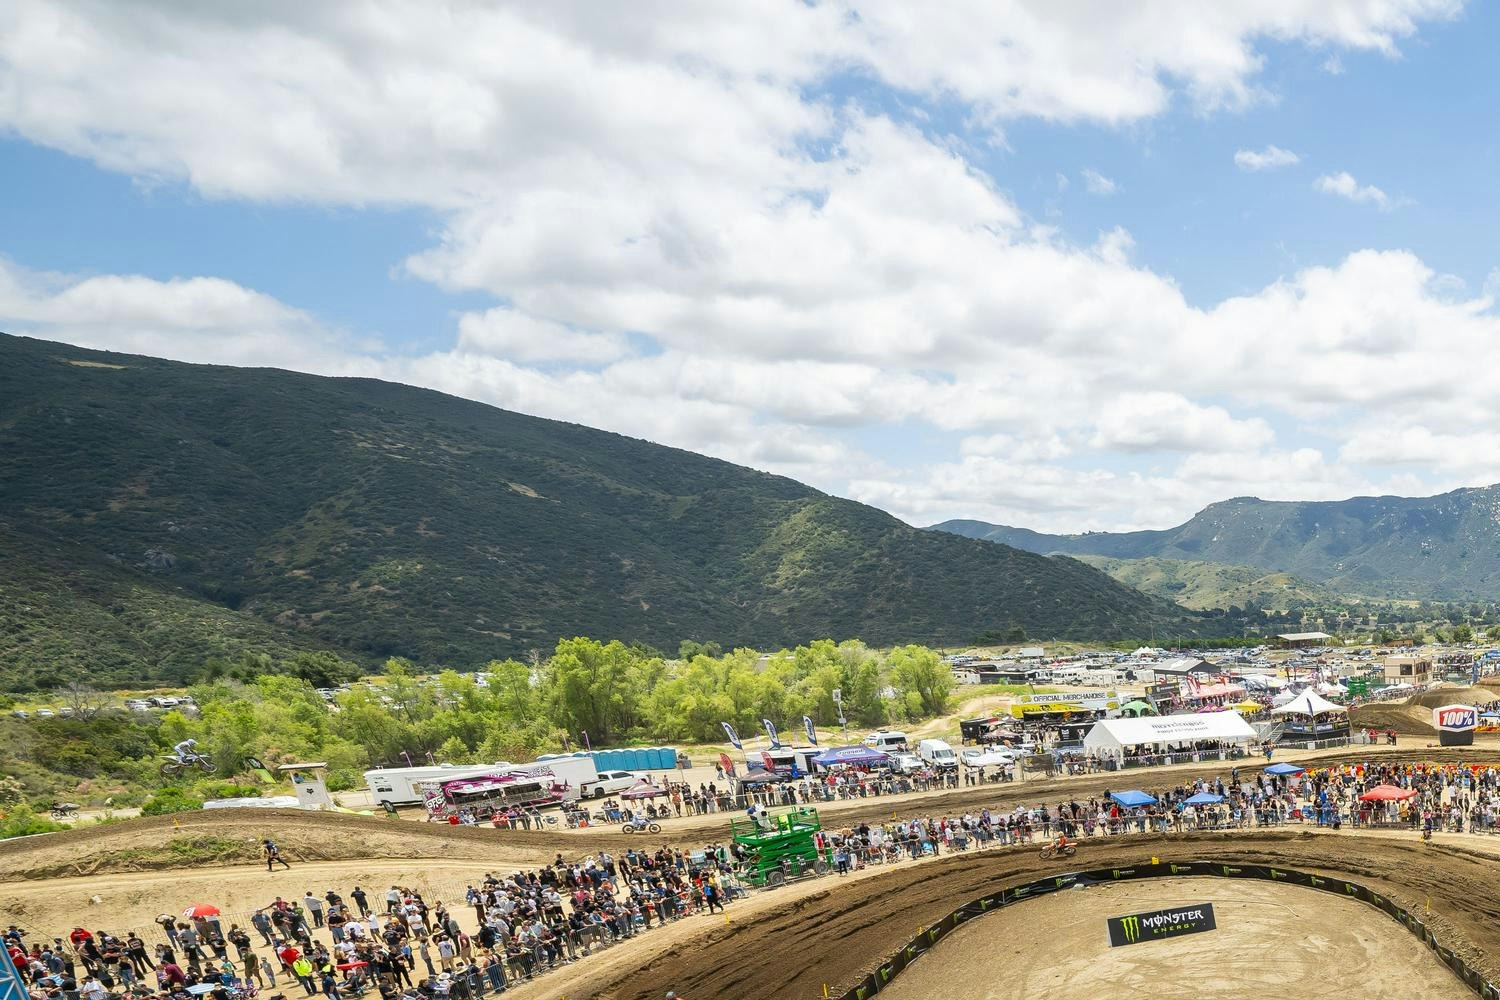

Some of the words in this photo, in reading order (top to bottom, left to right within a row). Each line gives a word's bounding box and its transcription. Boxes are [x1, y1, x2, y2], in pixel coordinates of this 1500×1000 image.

[1063, 692, 1106, 701] MERCHANDISE
[1442, 711, 1473, 726] 100%
[1143, 909, 1204, 929] MONSTER
[1153, 922, 1196, 934] ENERGY
